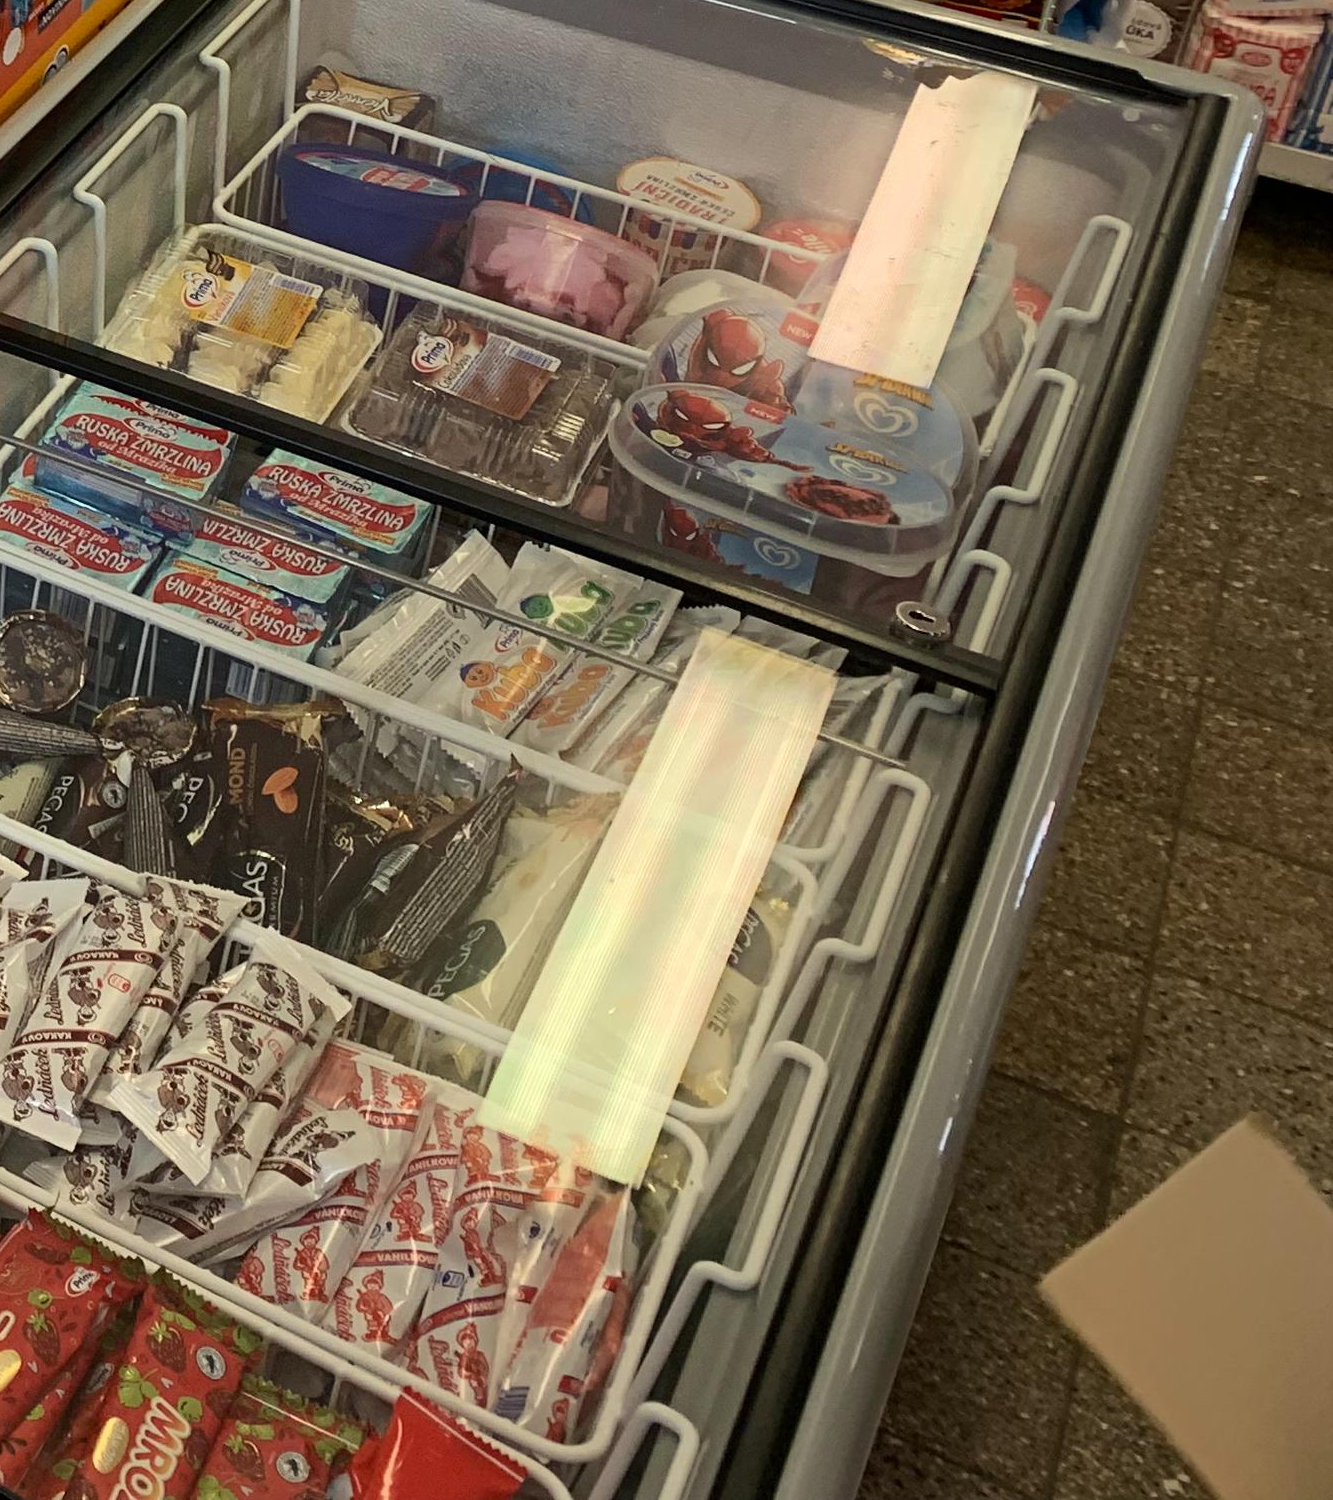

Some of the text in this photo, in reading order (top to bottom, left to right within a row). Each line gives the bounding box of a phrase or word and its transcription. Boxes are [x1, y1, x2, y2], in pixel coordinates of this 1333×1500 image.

[191, 277, 213, 302] Prima
[422, 339, 448, 368] Prima
[134, 418, 175, 438] Prima
[127, 434, 213, 479] ZMRZLINA
[321, 483, 406, 532] ZMRZLINA
[164, 574, 252, 627] ZMRZLINA
[428, 923, 487, 999] PEGAS
